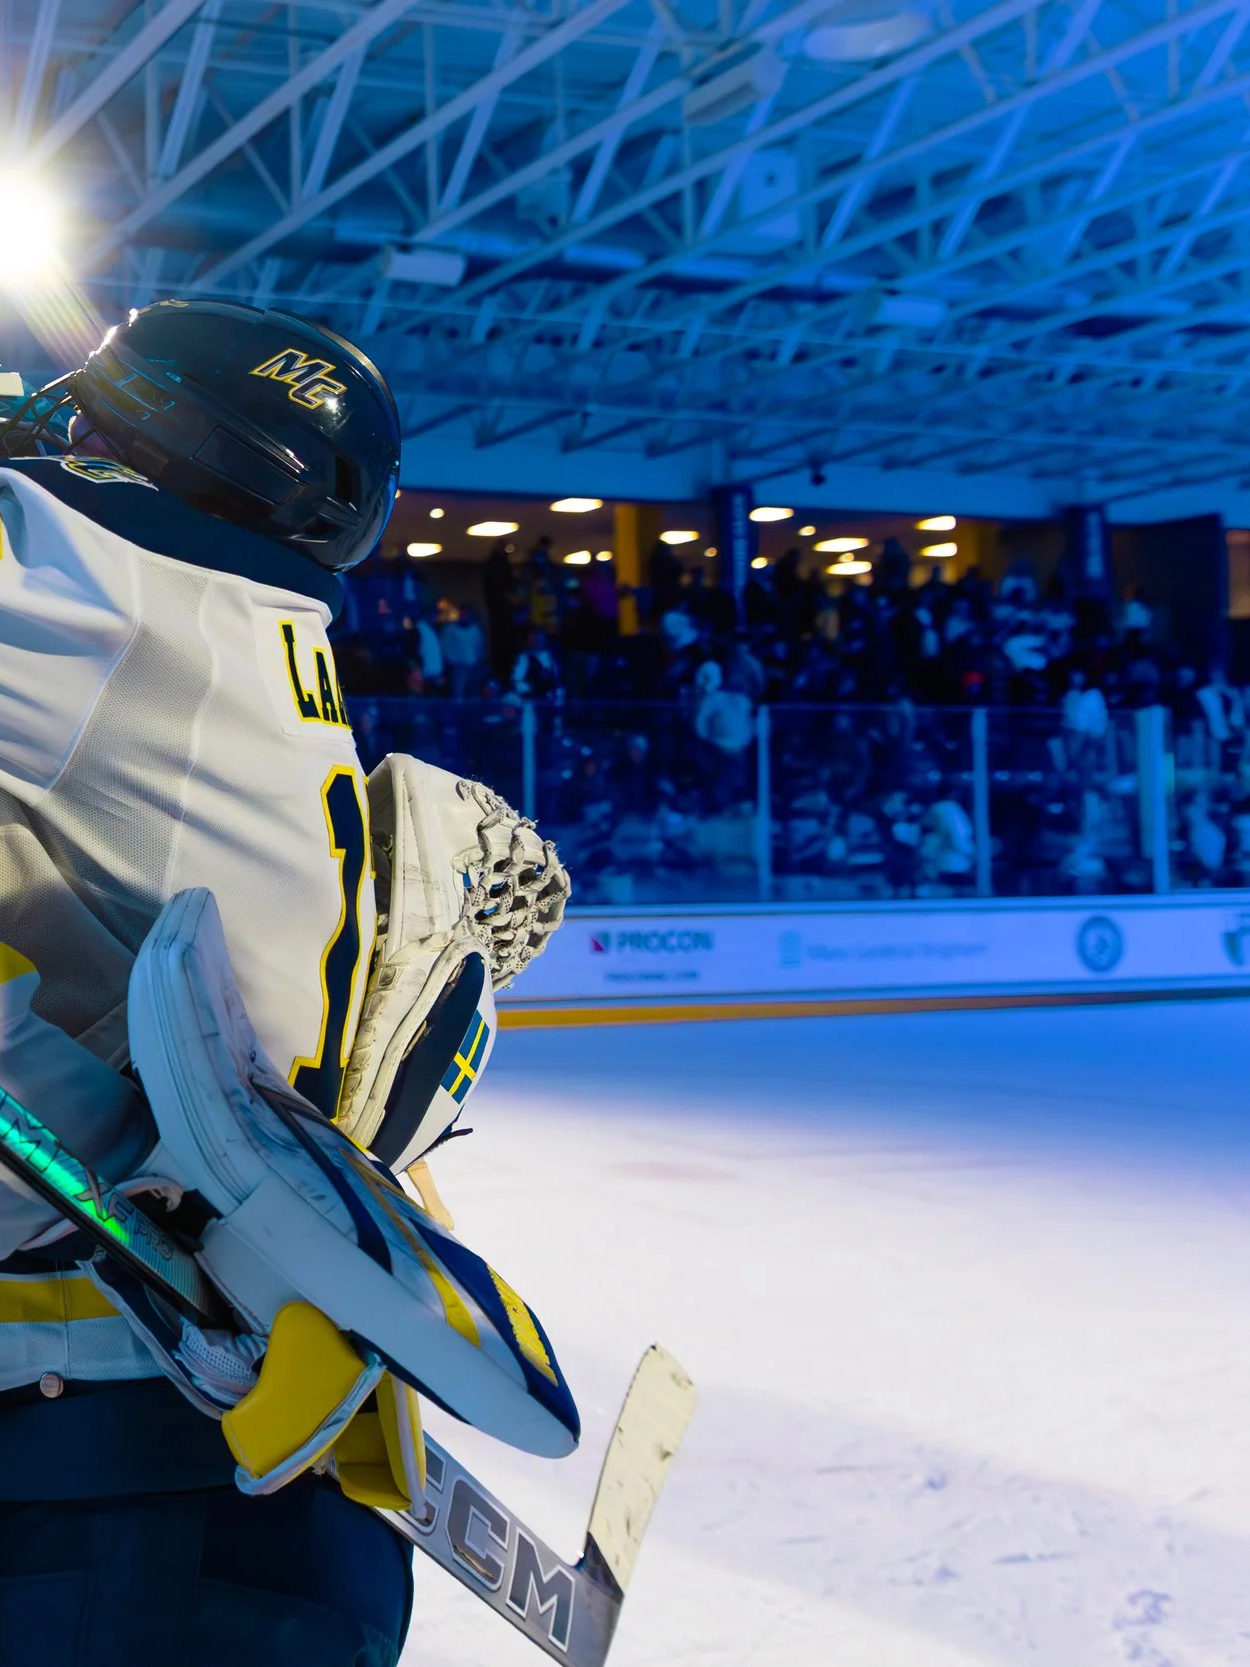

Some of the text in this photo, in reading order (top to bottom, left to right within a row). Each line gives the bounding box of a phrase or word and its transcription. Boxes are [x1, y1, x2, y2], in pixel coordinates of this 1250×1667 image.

[247, 348, 348, 410] MC
[278, 619, 353, 732] LA
[288, 763, 378, 1124] 1
[617, 930, 714, 953] PROCON
